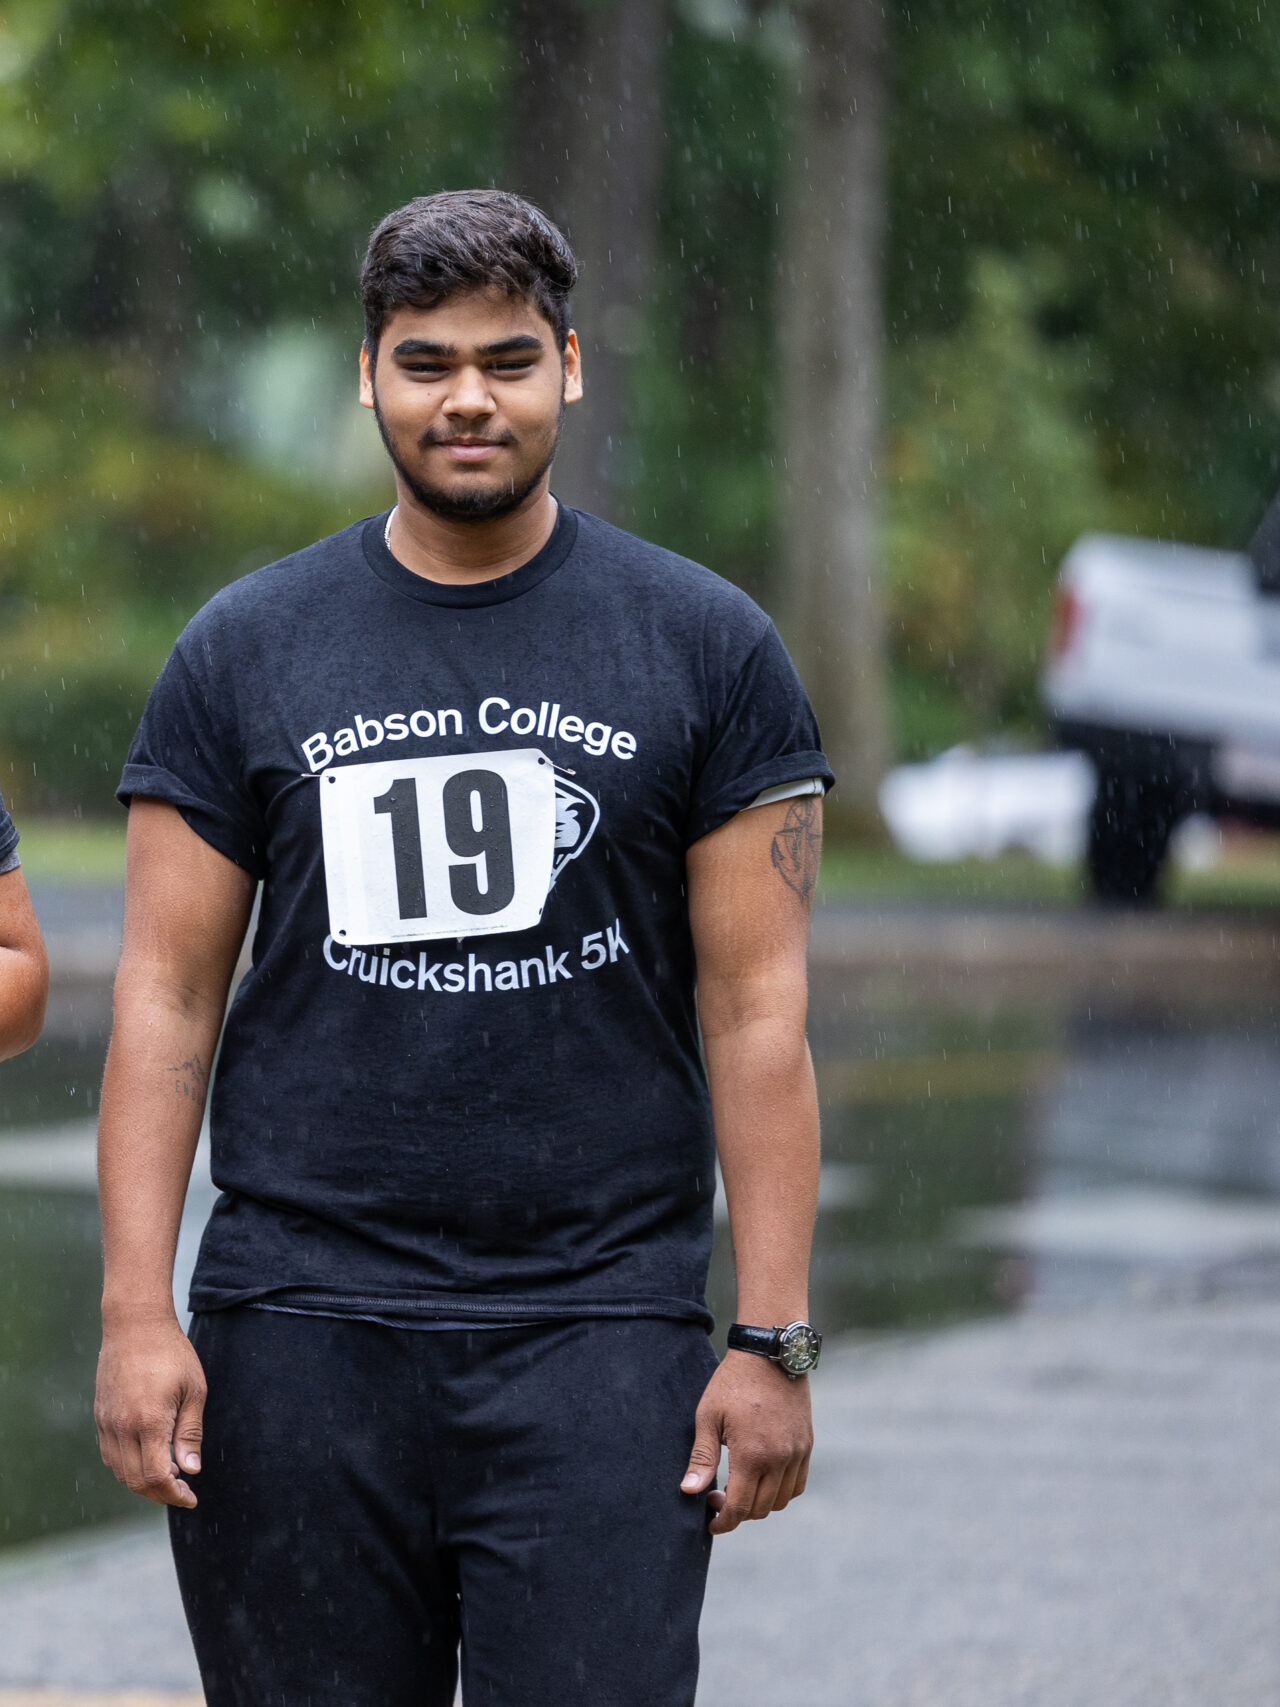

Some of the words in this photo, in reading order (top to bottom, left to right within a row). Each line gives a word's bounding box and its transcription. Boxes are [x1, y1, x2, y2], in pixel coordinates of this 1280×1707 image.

[301, 708, 464, 774] Babson
[478, 697, 638, 761] College
[373, 768, 515, 920] 19
[322, 932, 574, 993] Cruickshank
